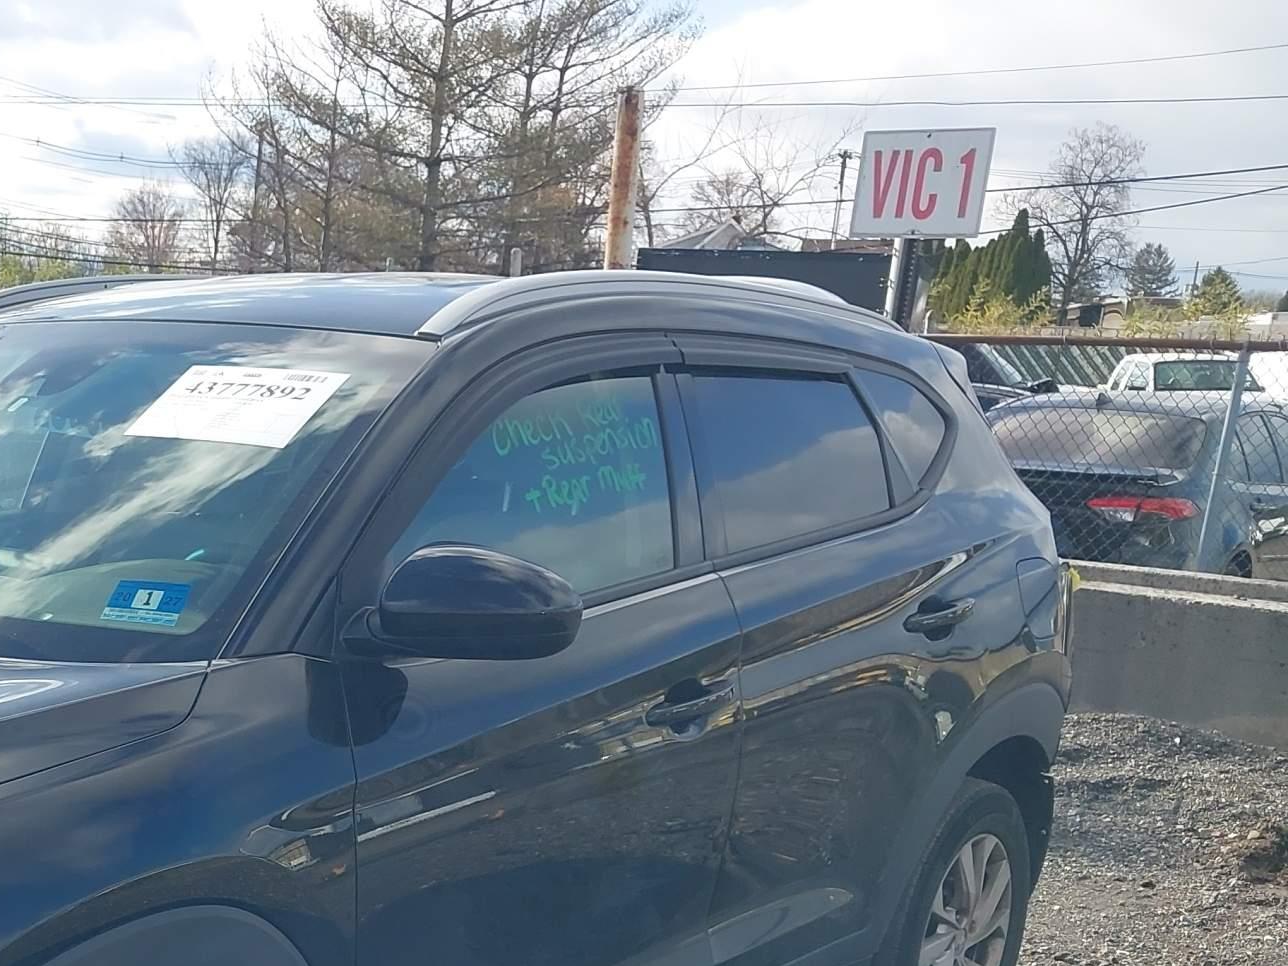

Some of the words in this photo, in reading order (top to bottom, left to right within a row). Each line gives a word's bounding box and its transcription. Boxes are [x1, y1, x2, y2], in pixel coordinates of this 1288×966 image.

[872, 147, 944, 221] VIC
[957, 147, 978, 219] 1
[184, 380, 312, 401] 43777892
[114, 591, 132, 602] 20
[143, 591, 153, 606] 1
[163, 596, 182, 607] 27
